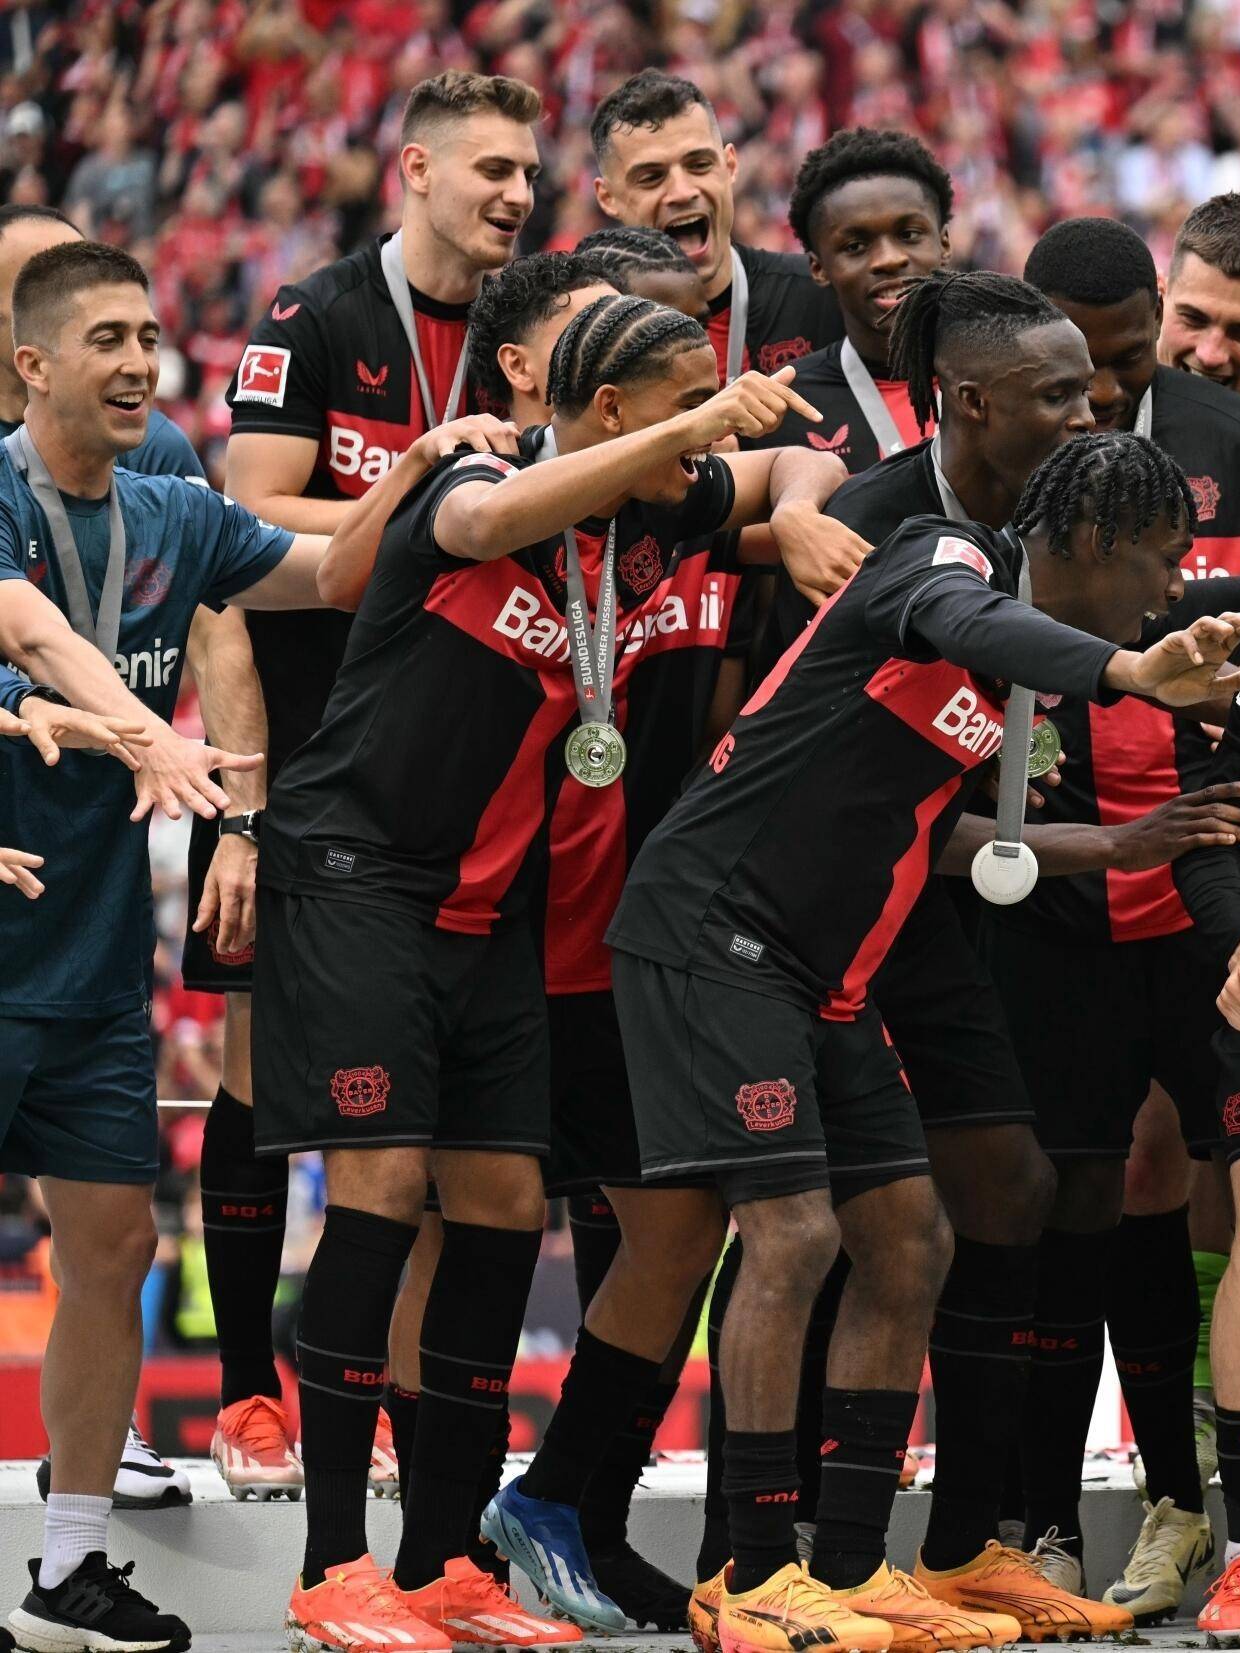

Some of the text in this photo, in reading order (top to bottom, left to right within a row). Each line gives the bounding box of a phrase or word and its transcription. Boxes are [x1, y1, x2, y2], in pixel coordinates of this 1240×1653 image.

[1136, 409, 1146, 434] 2024
[602, 536, 616, 633] FUSSBALLMEISTER
[571, 600, 593, 686] BUNDESLIGA
[222, 1205, 273, 1218] B04
